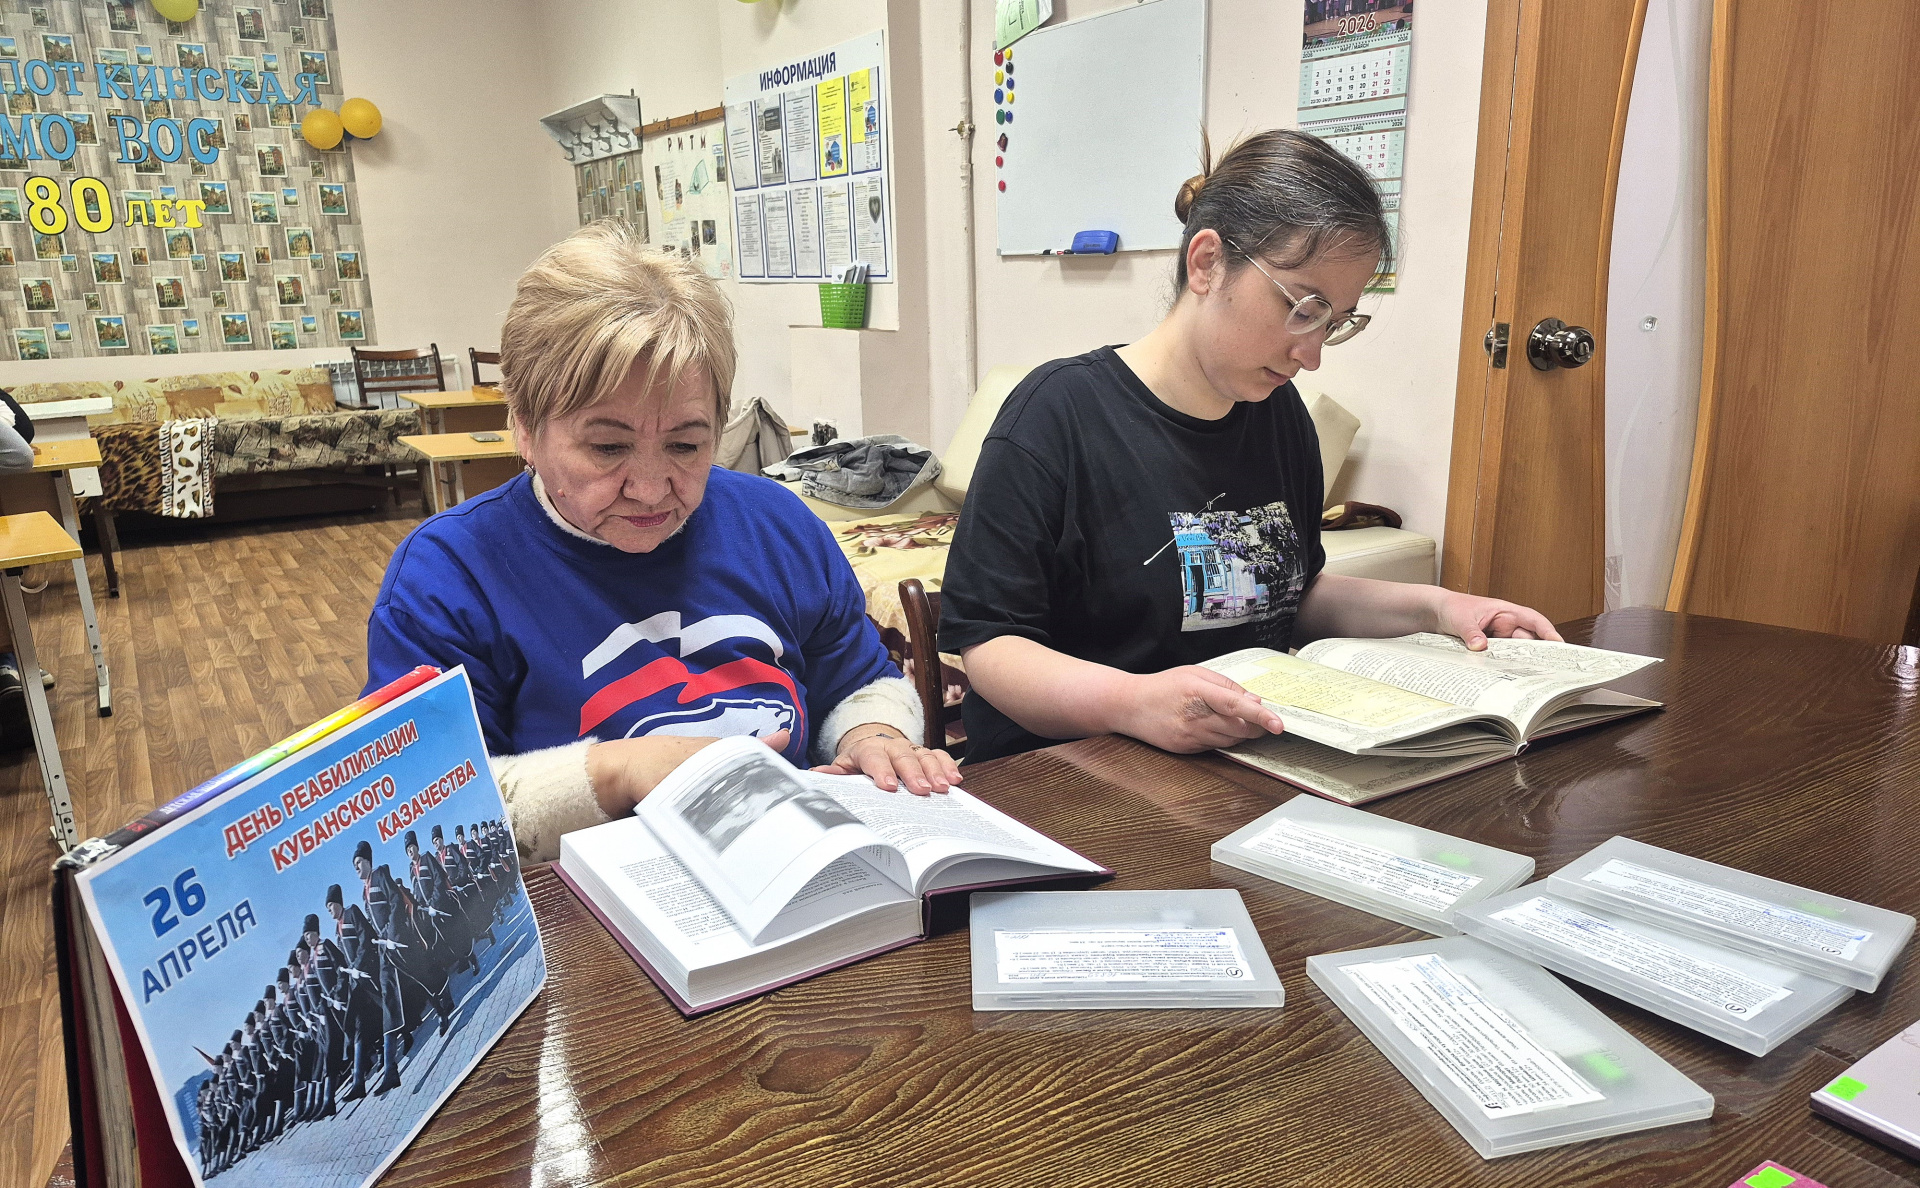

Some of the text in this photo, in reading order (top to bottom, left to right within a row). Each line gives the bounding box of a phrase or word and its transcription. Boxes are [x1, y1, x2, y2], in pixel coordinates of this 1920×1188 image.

[1338, 12, 1376, 37] 2026
[760, 52, 836, 91] ИНФОРМАЦИЯ
[111, 115, 219, 164] ВОС
[23, 176, 113, 234] 80
[223, 803, 283, 858] ДЕНЬ
[281, 719, 419, 818] РЕАБИЛИТАЦИИ
[270, 774, 396, 873] КУБАНСКОГО
[376, 759, 477, 843] КАЗАЧЕСТВА
[143, 868, 206, 938] 26
[142, 900, 257, 1004] АПРЕЛЯ
